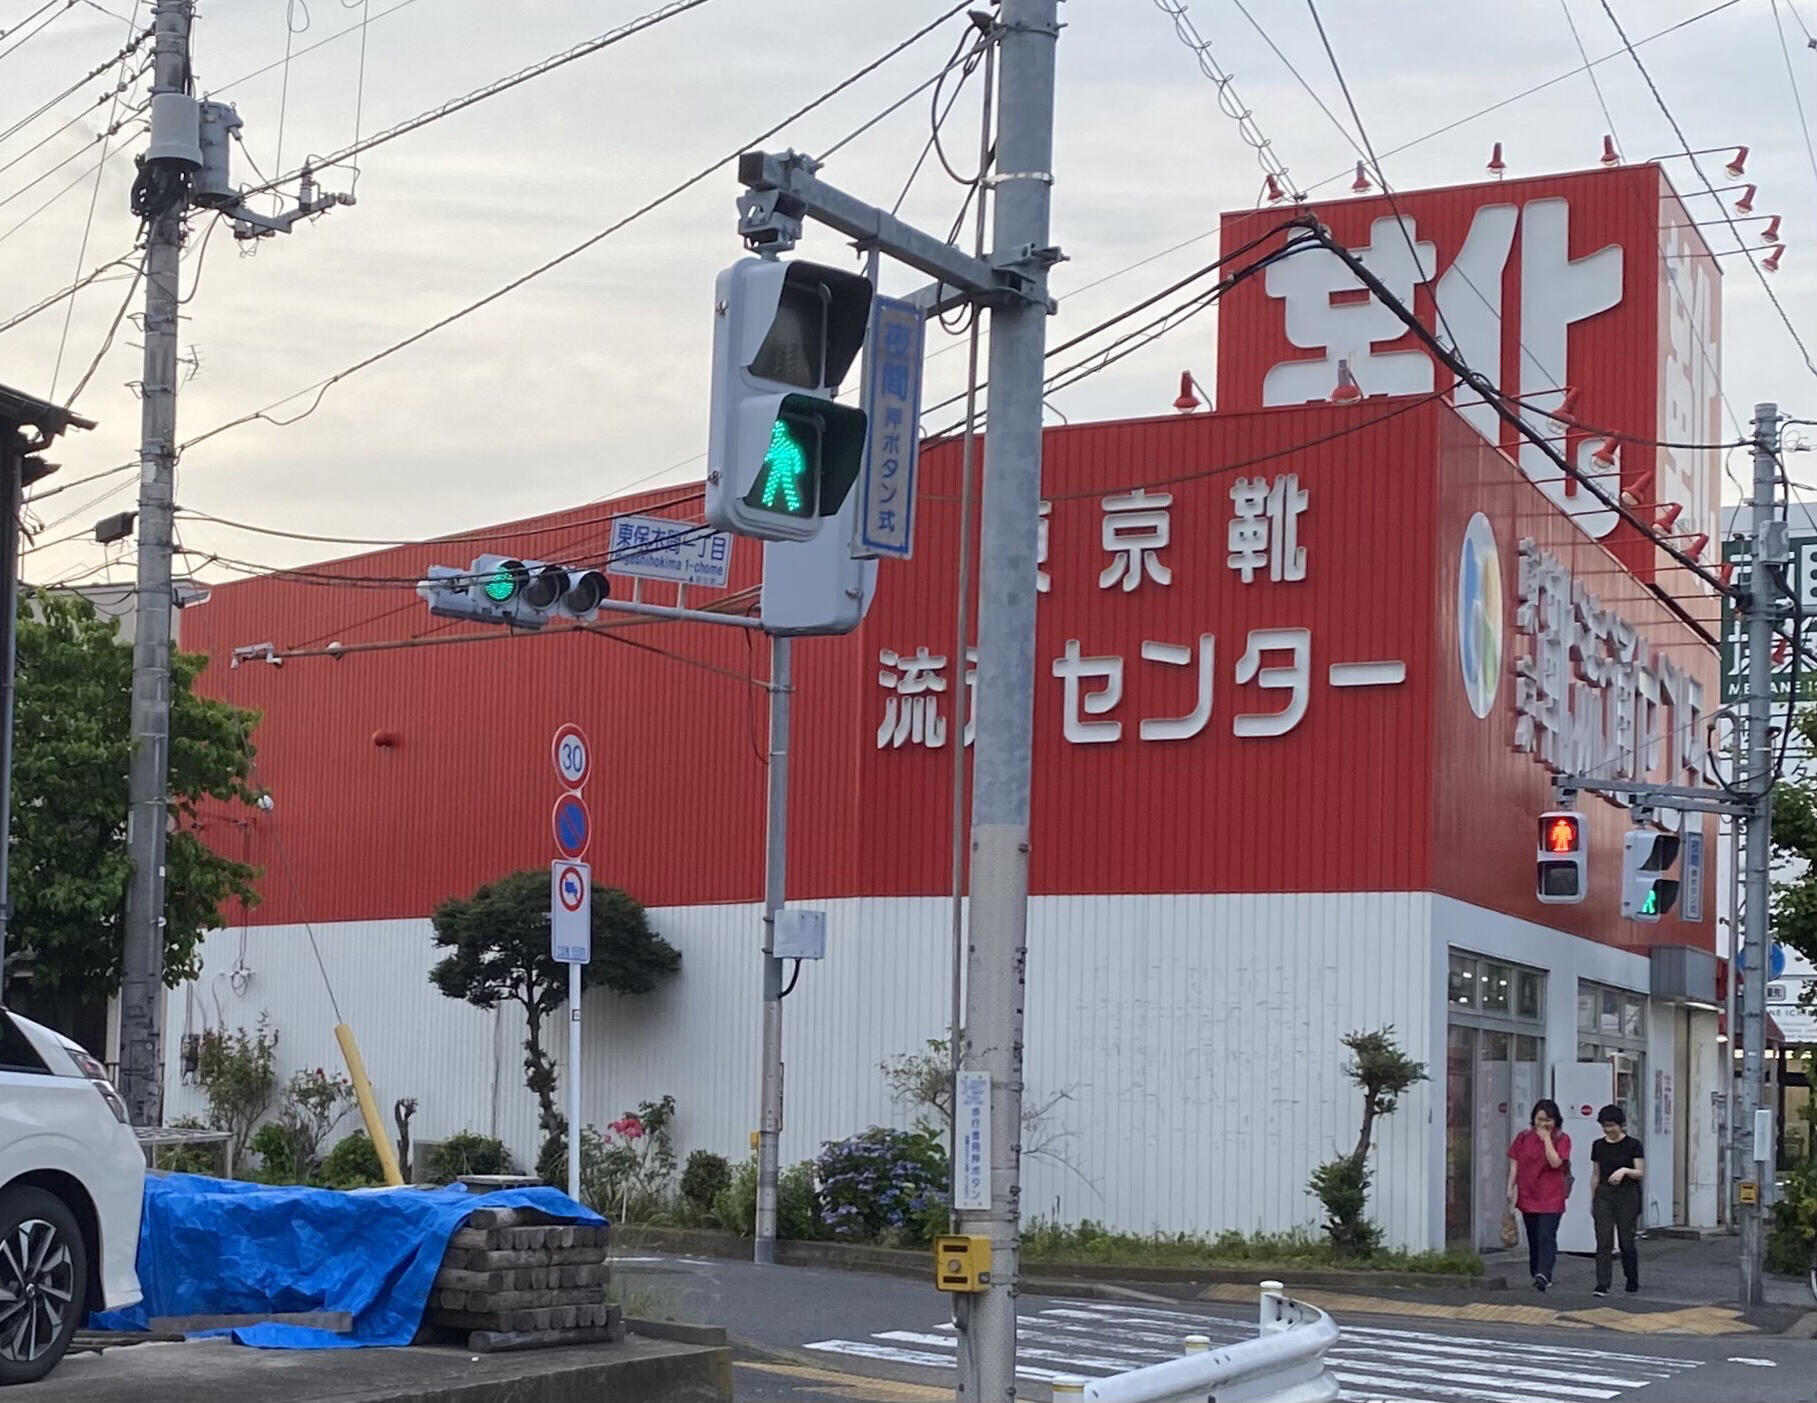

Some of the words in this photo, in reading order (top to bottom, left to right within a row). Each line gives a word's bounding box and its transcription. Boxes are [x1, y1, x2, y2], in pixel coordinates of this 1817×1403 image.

[1036, 473, 1310, 593] 京靴
[876, 626, 1408, 750] 流センター
[1728, 681, 1801, 695] MEANE
[562, 744, 583, 772] 30
